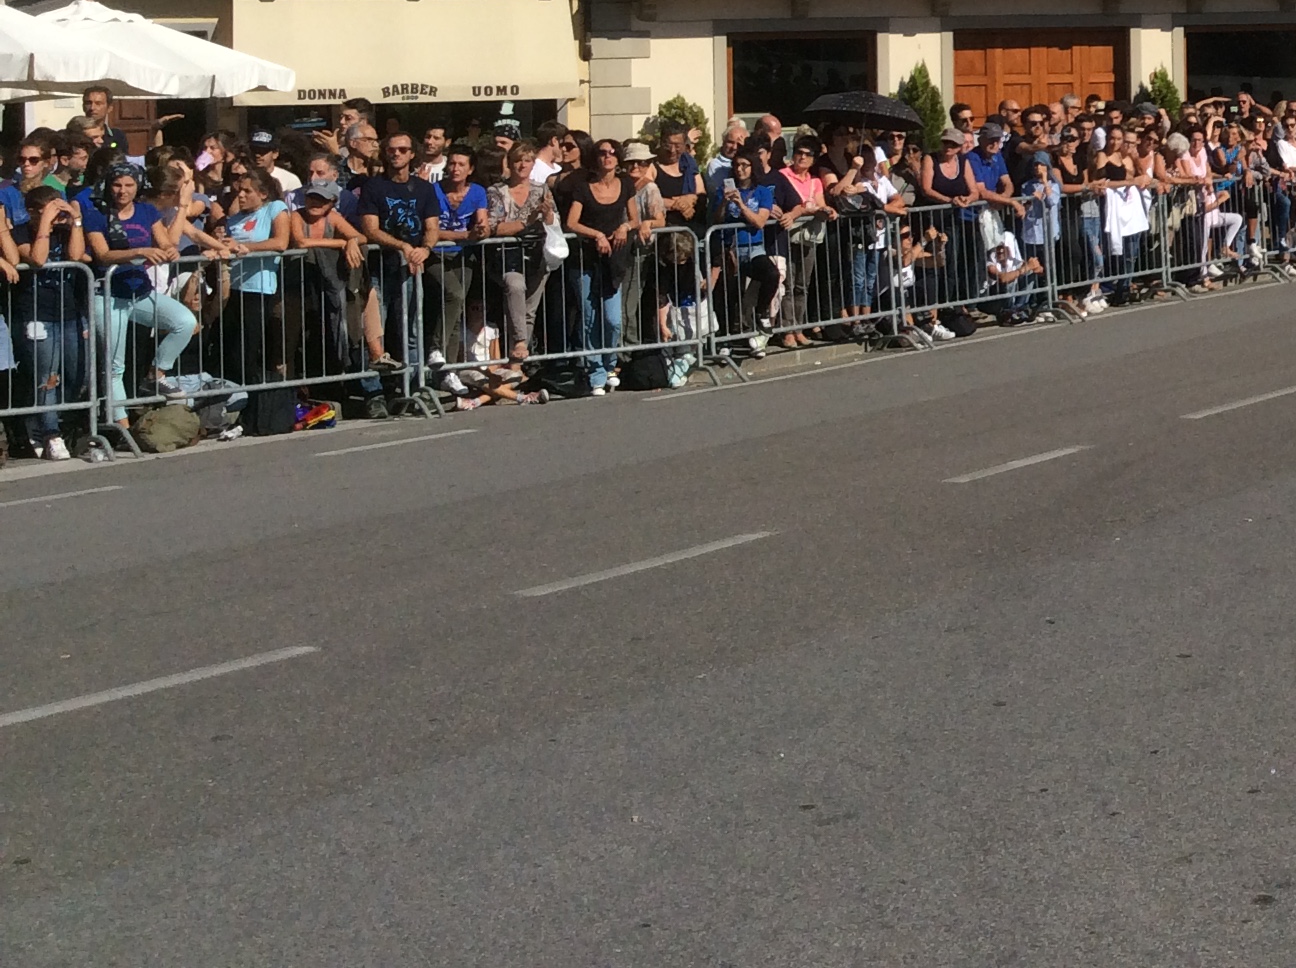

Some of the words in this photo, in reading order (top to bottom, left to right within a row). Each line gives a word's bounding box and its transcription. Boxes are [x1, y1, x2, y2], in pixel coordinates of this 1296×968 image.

[297, 88, 347, 101] DONNA
[382, 83, 438, 99] BARBER
[472, 85, 520, 97] UOMO
